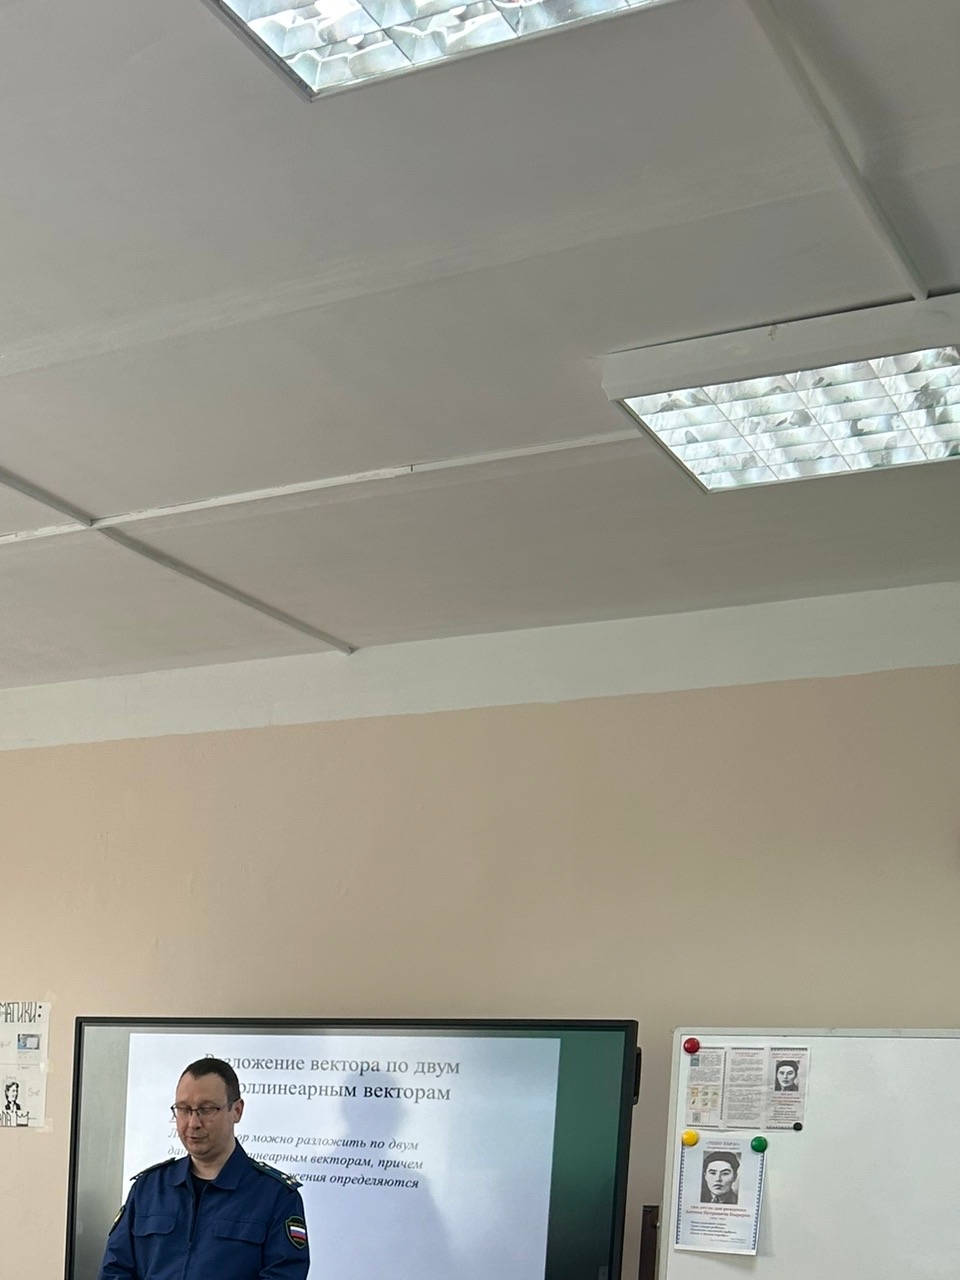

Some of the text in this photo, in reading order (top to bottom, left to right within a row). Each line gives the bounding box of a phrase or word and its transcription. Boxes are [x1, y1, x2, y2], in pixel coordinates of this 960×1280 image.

[205, 1053, 461, 1078] зложение вектора по двум
[239, 1081, 452, 1104] оллинеарным векторам
[251, 1134, 294, 1145] можно
[295, 1136, 367, 1149] разложить
[369, 1140, 385, 1149] по
[388, 1138, 419, 1153] двум
[310, 1155, 374, 1169] векторам,
[377, 1158, 423, 1171] причем
[329, 1174, 420, 1189] определяются
